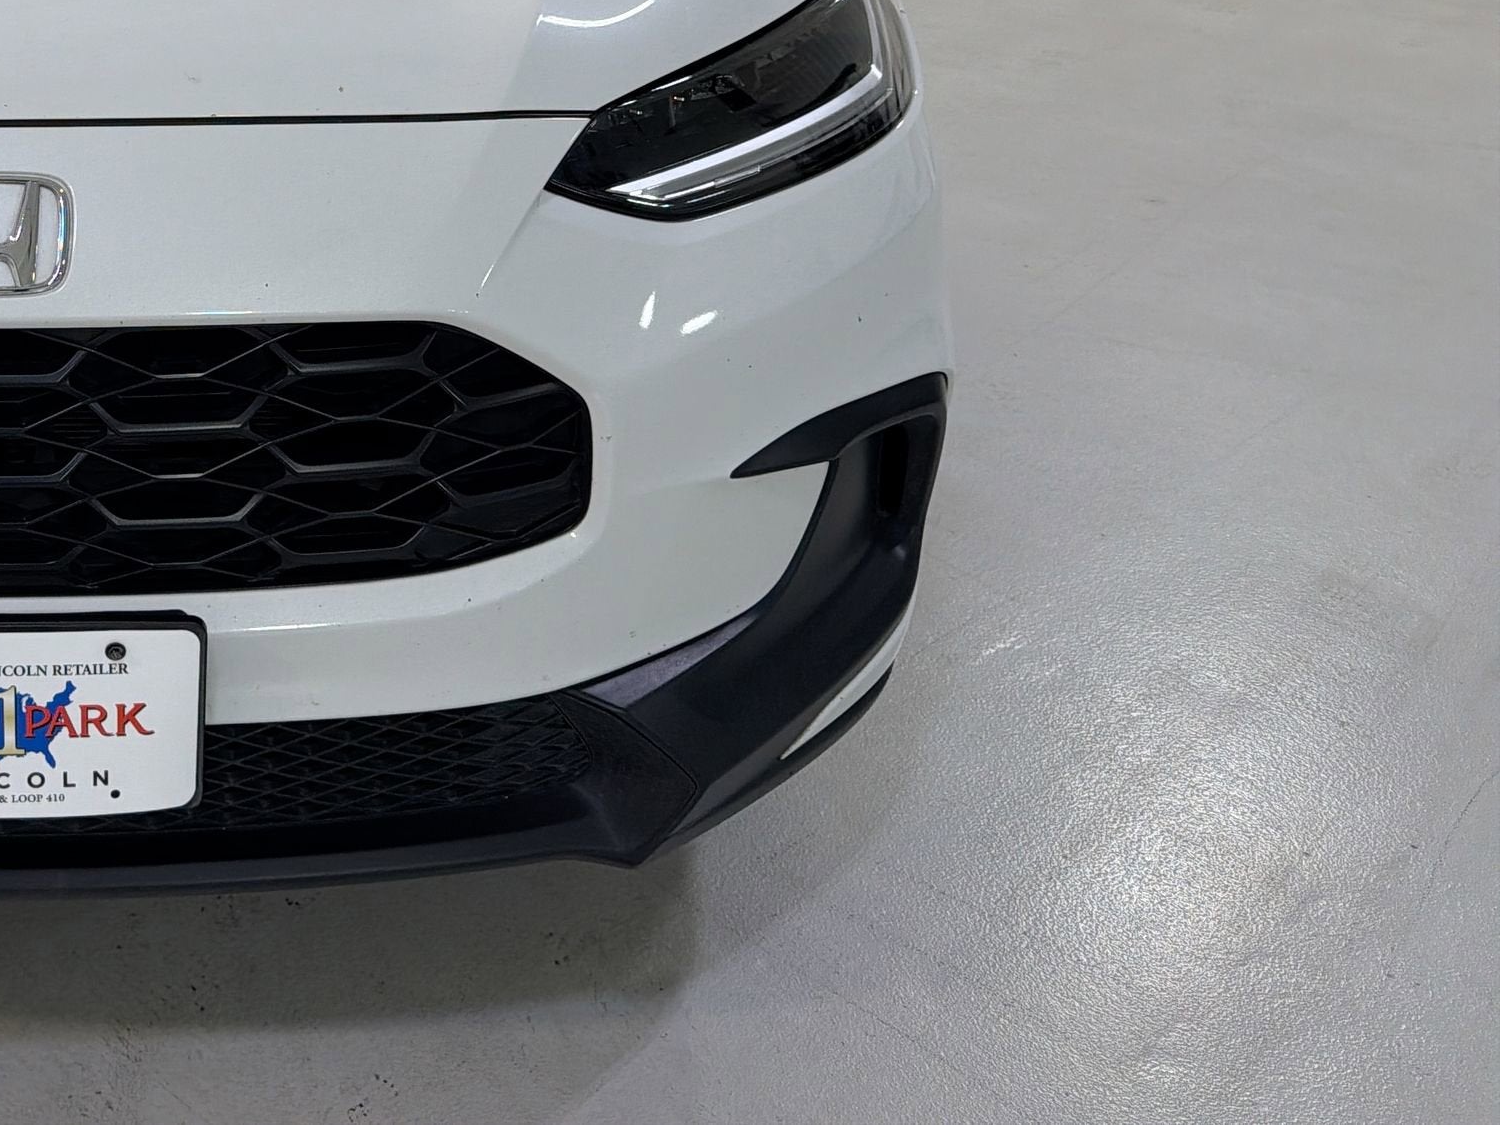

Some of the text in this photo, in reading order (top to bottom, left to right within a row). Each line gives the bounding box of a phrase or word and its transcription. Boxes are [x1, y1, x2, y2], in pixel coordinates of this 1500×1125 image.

[52, 663, 129, 676] RETAILER
[24, 702, 156, 739] PARK
[0, 793, 9, 804] &
[12, 793, 44, 804] LOOP
[46, 792, 66, 803] 410
